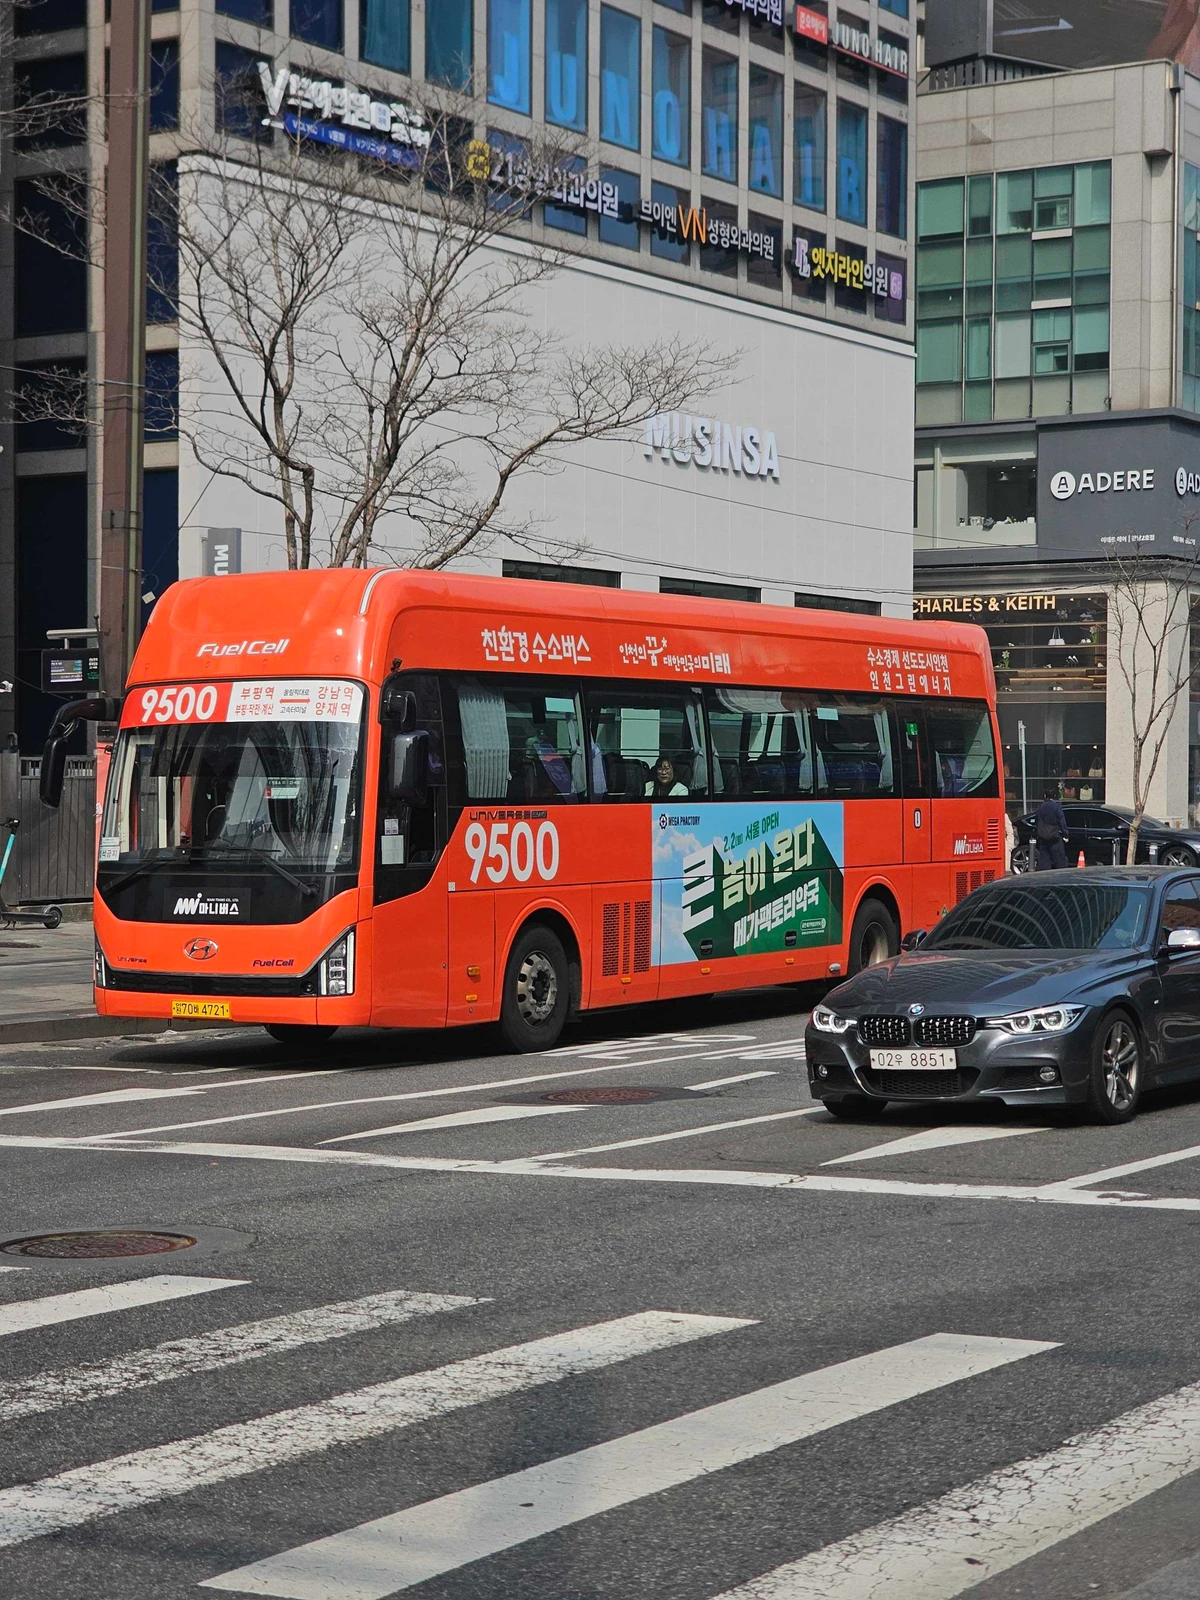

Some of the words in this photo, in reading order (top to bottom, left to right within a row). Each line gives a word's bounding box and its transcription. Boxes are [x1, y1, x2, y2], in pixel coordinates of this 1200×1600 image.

[832, 21, 870, 58] JUNO
[873, 40, 908, 75] HAIR
[492, 31, 681, 164] JUNO
[703, 107, 861, 220] HAIR
[640, 200, 677, 233] 브이엔
[678, 204, 706, 244] VN
[707, 219, 774, 261] 성형외과의원
[644, 410, 780, 481] MUSINSA
[1078, 469, 1155, 494] ADERE
[987, 597, 1000, 612] &
[1005, 595, 1056, 611] KEITH
[197, 641, 246, 659] Fuel
[247, 638, 290, 656] Cell
[481, 625, 529, 663] 친환경
[532, 631, 591, 665] 수소버스
[619, 643, 646, 665] 인천의
[645, 636, 668, 667] 꿈
[663, 652, 701, 674] 대한민국의
[702, 651, 732, 675] 미래
[867, 647, 900, 669] 수소경제
[140, 685, 219, 724] 9500
[240, 686, 275, 701] 부평역
[317, 685, 354, 701] 강남역
[280, 705, 307, 715] 고속터미널
[315, 702, 352, 717] 양재역
[469, 810, 530, 821] UNIVERSE
[668, 816, 680, 826] MEGA
[745, 820, 760, 841] 서울
[761, 811, 780, 834] OPEN
[464, 821, 560, 884] 9500
[682, 844, 715, 934] 큰
[722, 843, 766, 910] 놈이
[773, 818, 815, 883] 온다
[199, 902, 239, 915] 마니버스
[734, 877, 819, 949] 메가팩토리약국
[253, 959, 275, 967] Fuel
[275, 958, 294, 967] Cell
[202, 1004, 225, 1016] 4721
[877, 1052, 903, 1066] 02우
[910, 1052, 946, 1067] 8851
